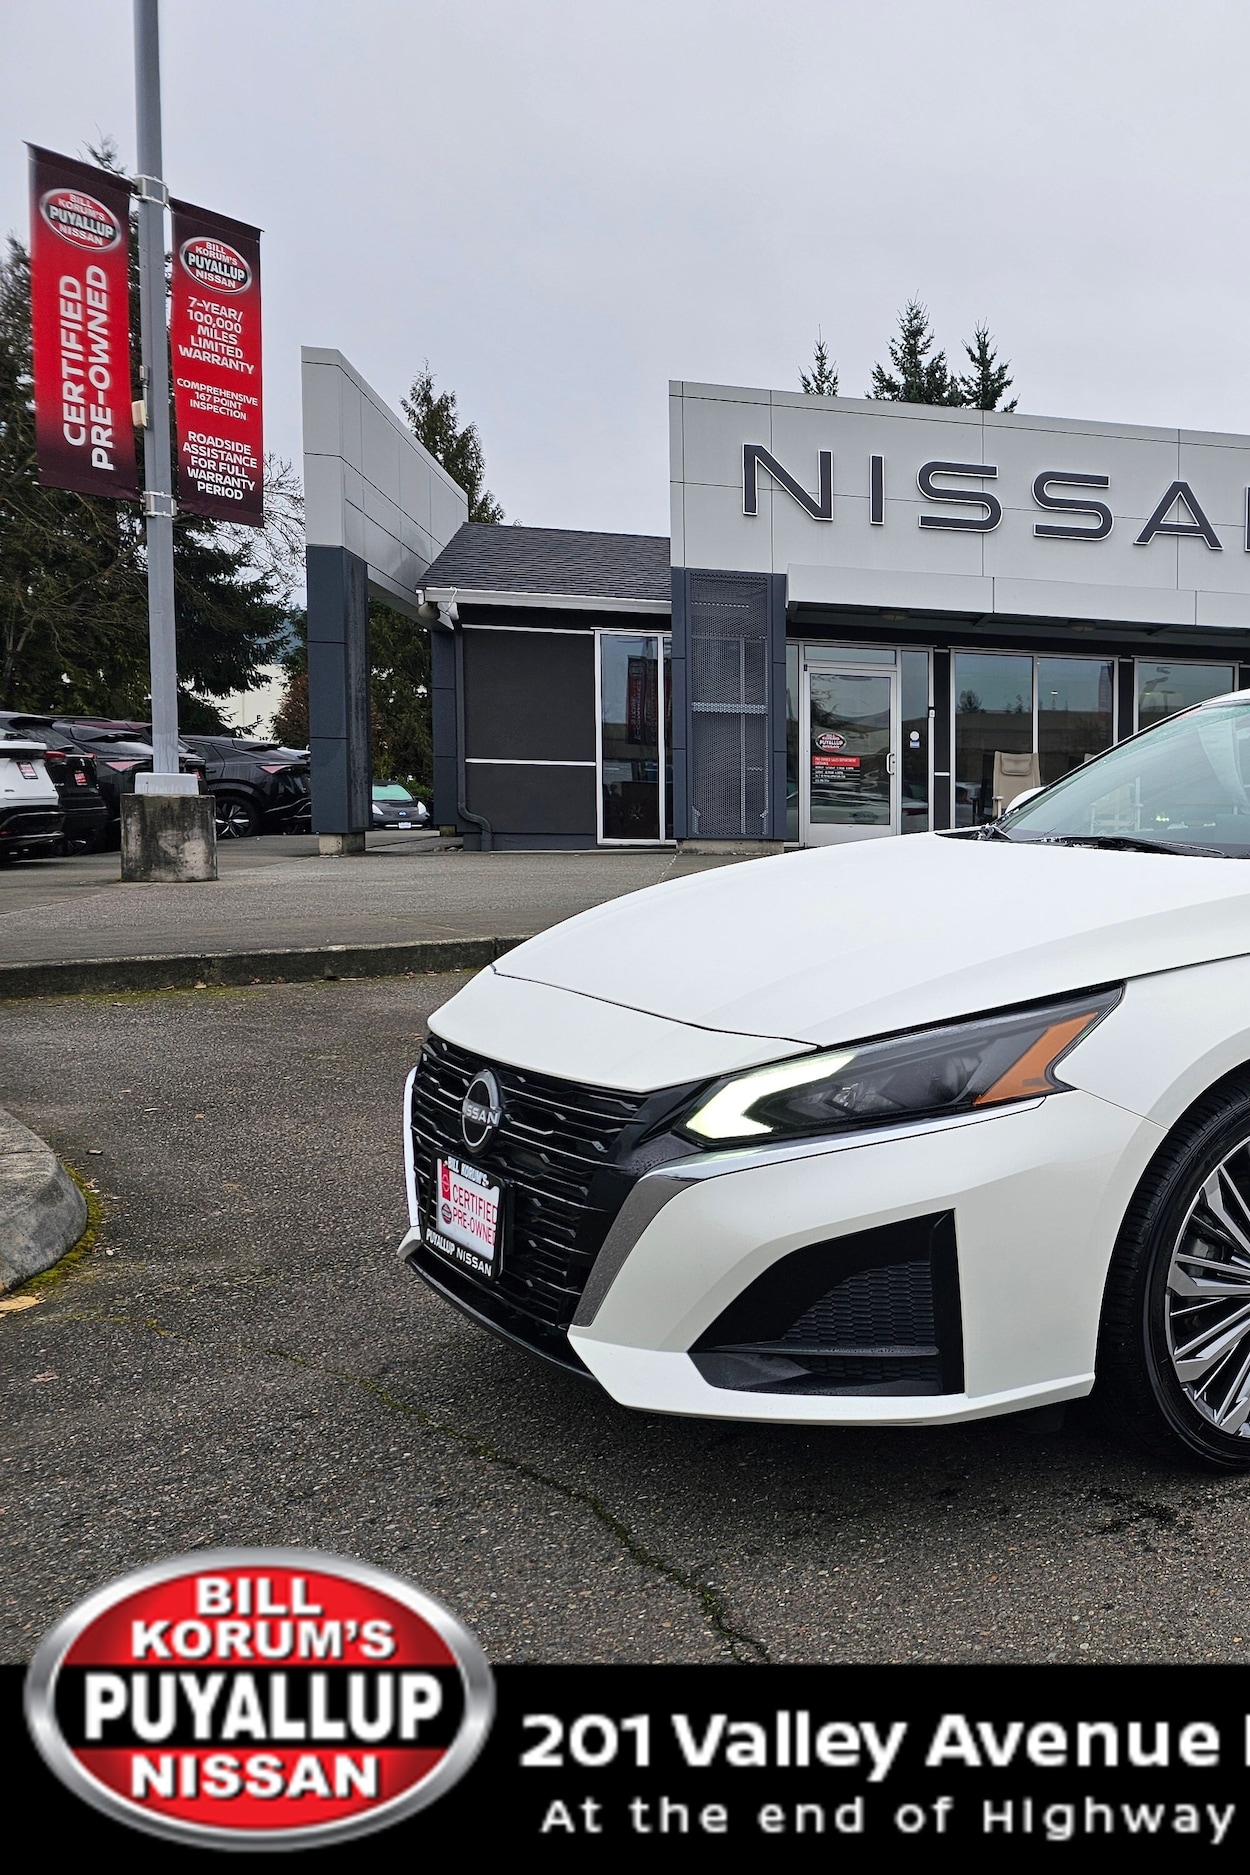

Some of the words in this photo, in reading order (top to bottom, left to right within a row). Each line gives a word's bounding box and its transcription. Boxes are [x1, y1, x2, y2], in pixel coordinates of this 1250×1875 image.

[58, 198, 105, 220] KORUM'S
[69, 193, 93, 209] BILL
[49, 204, 114, 238] PUYALLUP
[60, 224, 103, 246] NISSAN
[195, 246, 238, 266] KORUM'S
[205, 241, 226, 255] BILL
[188, 252, 246, 281] PUYALLUP
[195, 269, 236, 289] NISSAN
[186, 309, 242, 334] 100,000
[188, 296, 244, 322] 7-YEAR/
[190, 334, 244, 359] LIMITED
[197, 324, 238, 345] MILES
[59, 274, 86, 447] CERTIFIED
[86, 264, 115, 471] PRE-OWNED
[178, 344, 255, 375] WARRANTY
[176, 377, 258, 406] COMPREHENSIVE
[194, 391, 211, 401] 167
[213, 396, 243, 410] POINT
[189, 399, 247, 421] INSPECTION
[182, 441, 258, 469] ASSISTANCE
[187, 430, 252, 456] ROADSIDE
[186, 466, 256, 491] WARRANTY
[190, 455, 217, 472] FOR
[218, 461, 249, 478] FULL
[197, 480, 244, 501] PERIOD
[464, 1103, 499, 1125] SSAN
[452, 1184, 498, 1225] CERTIFIED
[456, 1247, 492, 1277] NISSAN
